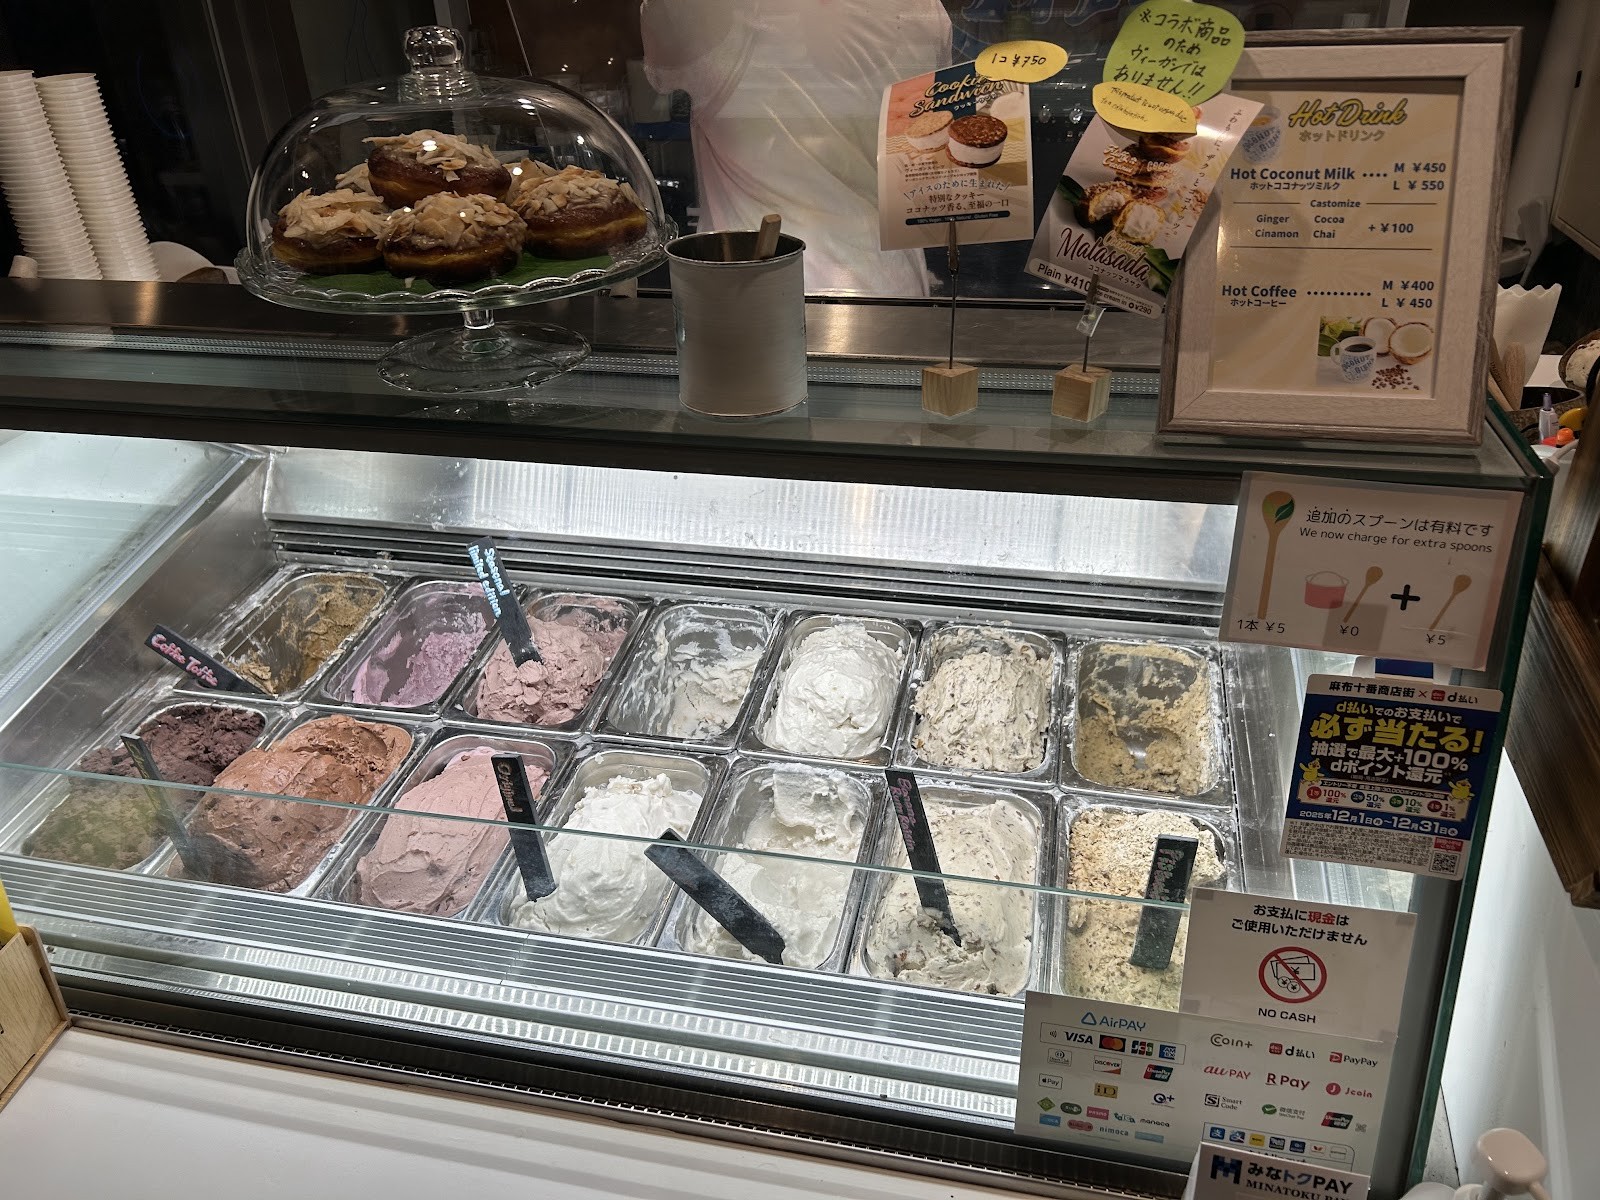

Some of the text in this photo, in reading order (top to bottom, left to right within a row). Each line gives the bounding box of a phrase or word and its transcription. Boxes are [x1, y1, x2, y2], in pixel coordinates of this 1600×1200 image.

[1164, 37, 1201, 55] のため
[1131, 44, 1206, 77] ヴィーガンでは
[909, 79, 1003, 117] Sandwich
[1288, 98, 1408, 127] Hot Drink
[1299, 129, 1386, 143] ホットドリンク
[1230, 167, 1355, 181] Hot Coconut Milk
[1394, 162, 1446, 173] M ¥450
[1250, 181, 1341, 191] ホットココナッツミルク
[1393, 180, 1400, 190] L
[929, 192, 984, 203] 特別なクッキー
[1310, 198, 1361, 209] Castomize
[906, 199, 1009, 214] ココナッツ香る、至福の一口
[1256, 214, 1345, 225] Ginger Cocoa
[1255, 229, 1336, 239] Cinamon Chai
[1057, 227, 1150, 281] Malasada
[1037, 263, 1061, 280] Plain
[1088, 264, 1141, 289] ココナッツマラサダ
[1221, 285, 1297, 298] Hot Coffee
[1382, 280, 1435, 291] M ¥400
[1230, 298, 1287, 308] ホットコーヒー
[1382, 298, 1388, 307] L
[1306, 507, 1493, 537] 追加のスプーンは有料です
[1300, 527, 1492, 553] We now charge for extra spoons
[1237, 619, 1258, 632] 1本
[1329, 681, 1415, 698] 麻布十番商店街
[1336, 700, 1462, 724] d払いでのお支払いで
[1330, 759, 1444, 785] dポイント還元
[1253, 904, 1350, 926] お支払に現金は
[1231, 918, 1368, 946] ご使用いただけません
[1099, 1015, 1146, 1032] AirPAY
[1258, 1008, 1316, 1024] NO CASH
[1064, 1031, 1094, 1045] VISA
[1285, 1046, 1315, 1059] d払い
[1343, 1055, 1378, 1068] PayPay
[1203, 1065, 1251, 1080] au PAY
[1280, 1075, 1310, 1090] Pay
[1221, 1102, 1238, 1111] Code
[1099, 1126, 1129, 1137] nimoca
[1248, 1162, 1353, 1195] みなトクPAY
[1246, 1179, 1320, 1200] MINATOKU
